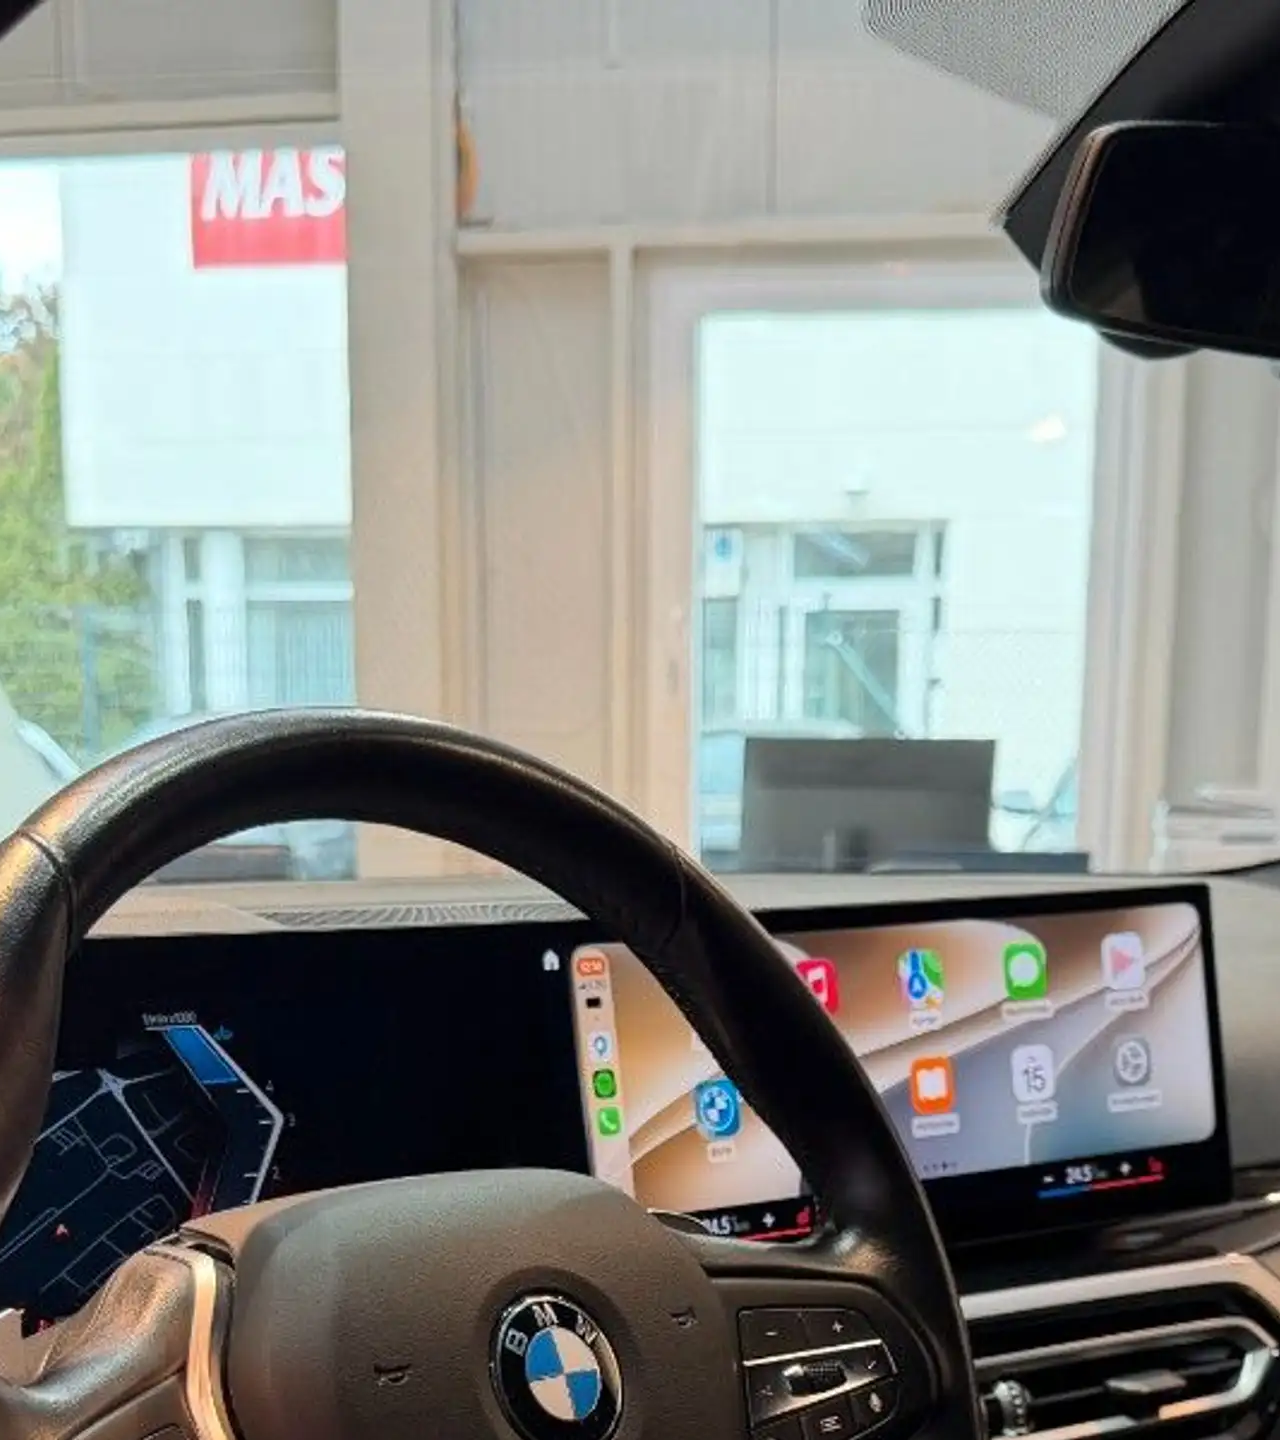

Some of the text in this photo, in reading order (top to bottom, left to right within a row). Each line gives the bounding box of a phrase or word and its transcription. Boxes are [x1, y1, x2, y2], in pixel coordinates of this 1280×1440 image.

[201, 147, 346, 221] MAS
[1023, 1065, 1047, 1094] 15
[505, 1302, 599, 1357] BMW
